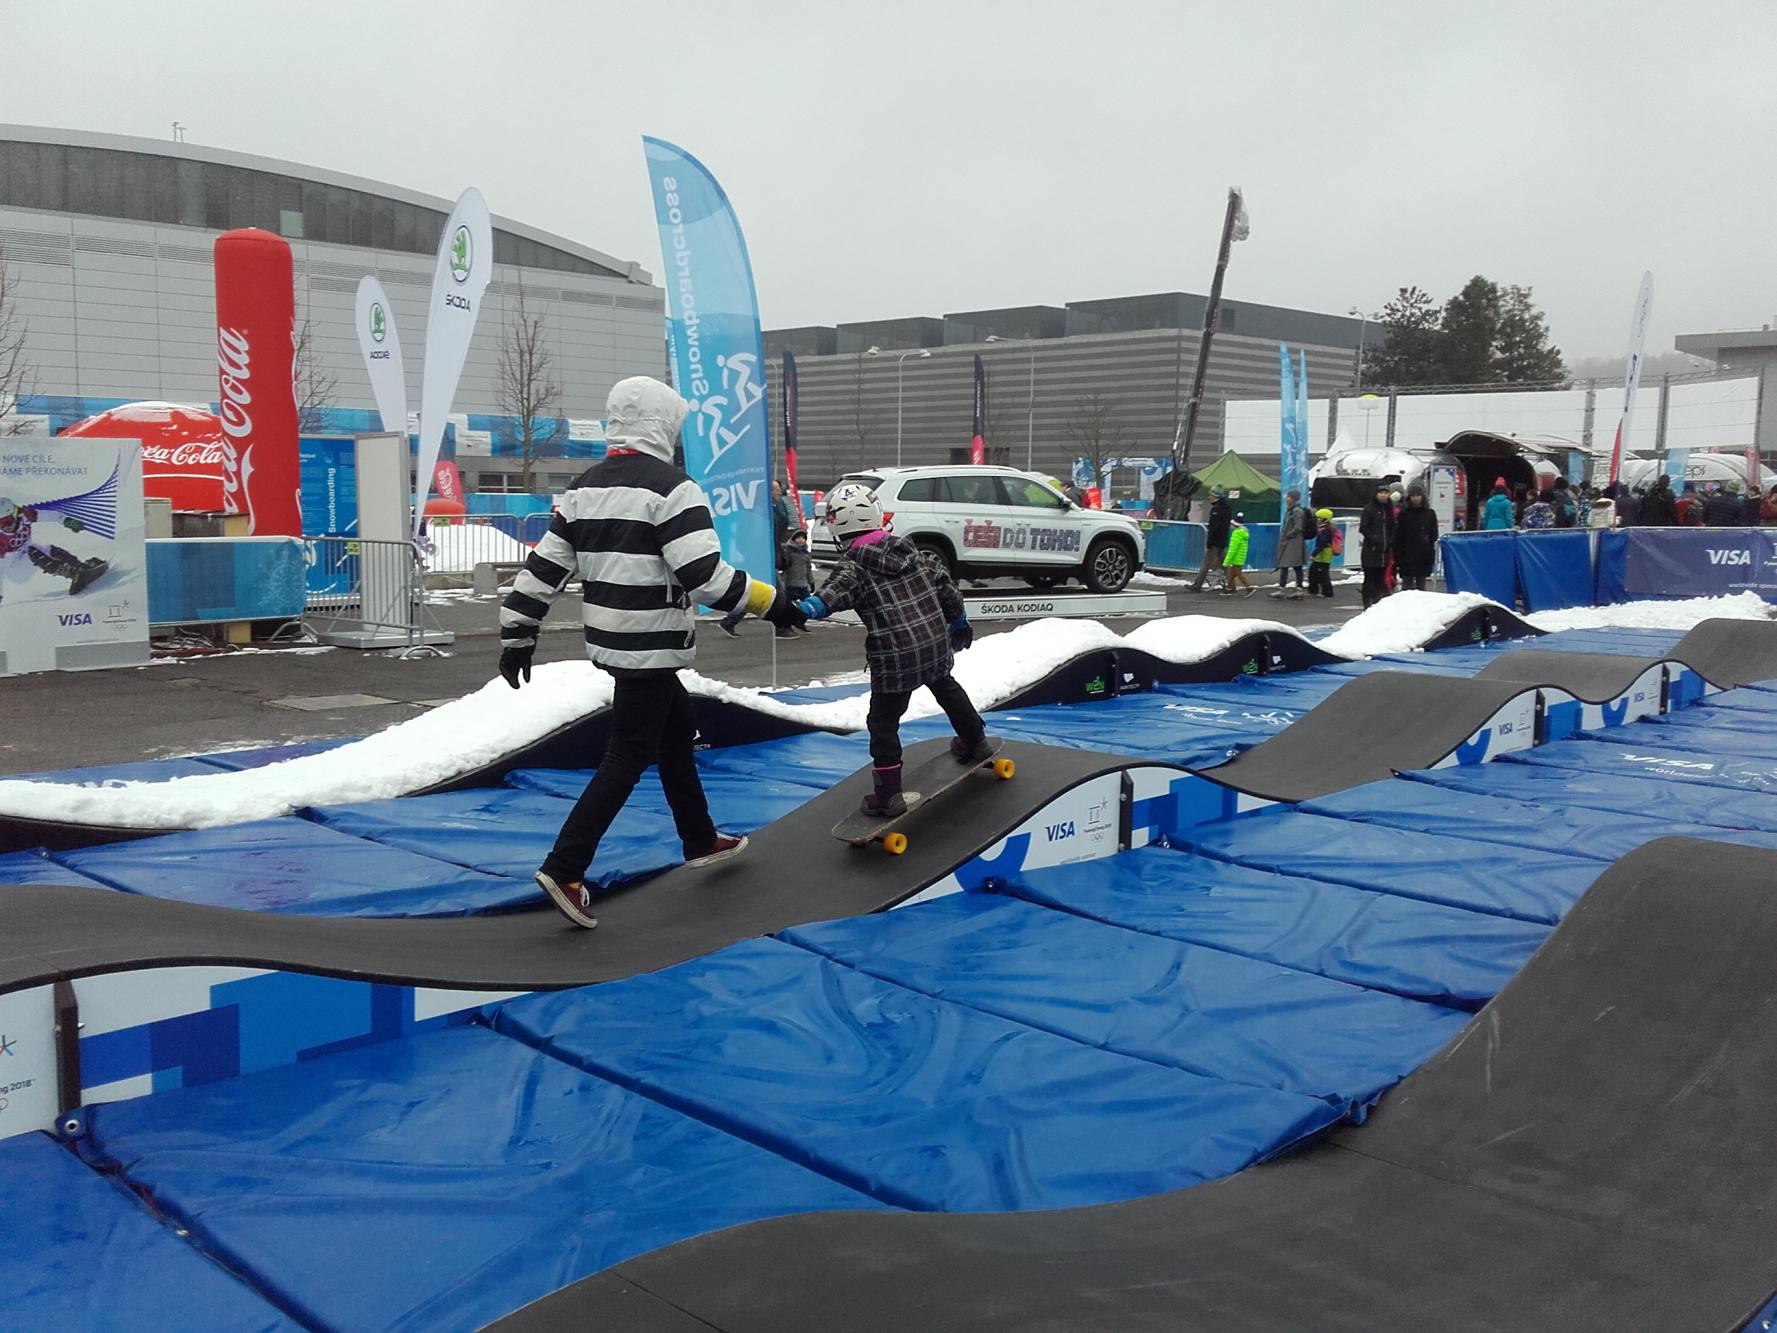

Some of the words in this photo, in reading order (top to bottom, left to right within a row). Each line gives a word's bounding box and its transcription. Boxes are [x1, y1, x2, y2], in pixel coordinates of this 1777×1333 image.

[328, 467, 337, 533] Snowboarding
[1705, 549, 1751, 565] VISA
[981, 603, 1014, 614] ŠKODA
[1017, 602, 1054, 613] KODIAQ
[56, 613, 93, 627] VISA
[1044, 820, 1076, 842] VISA
